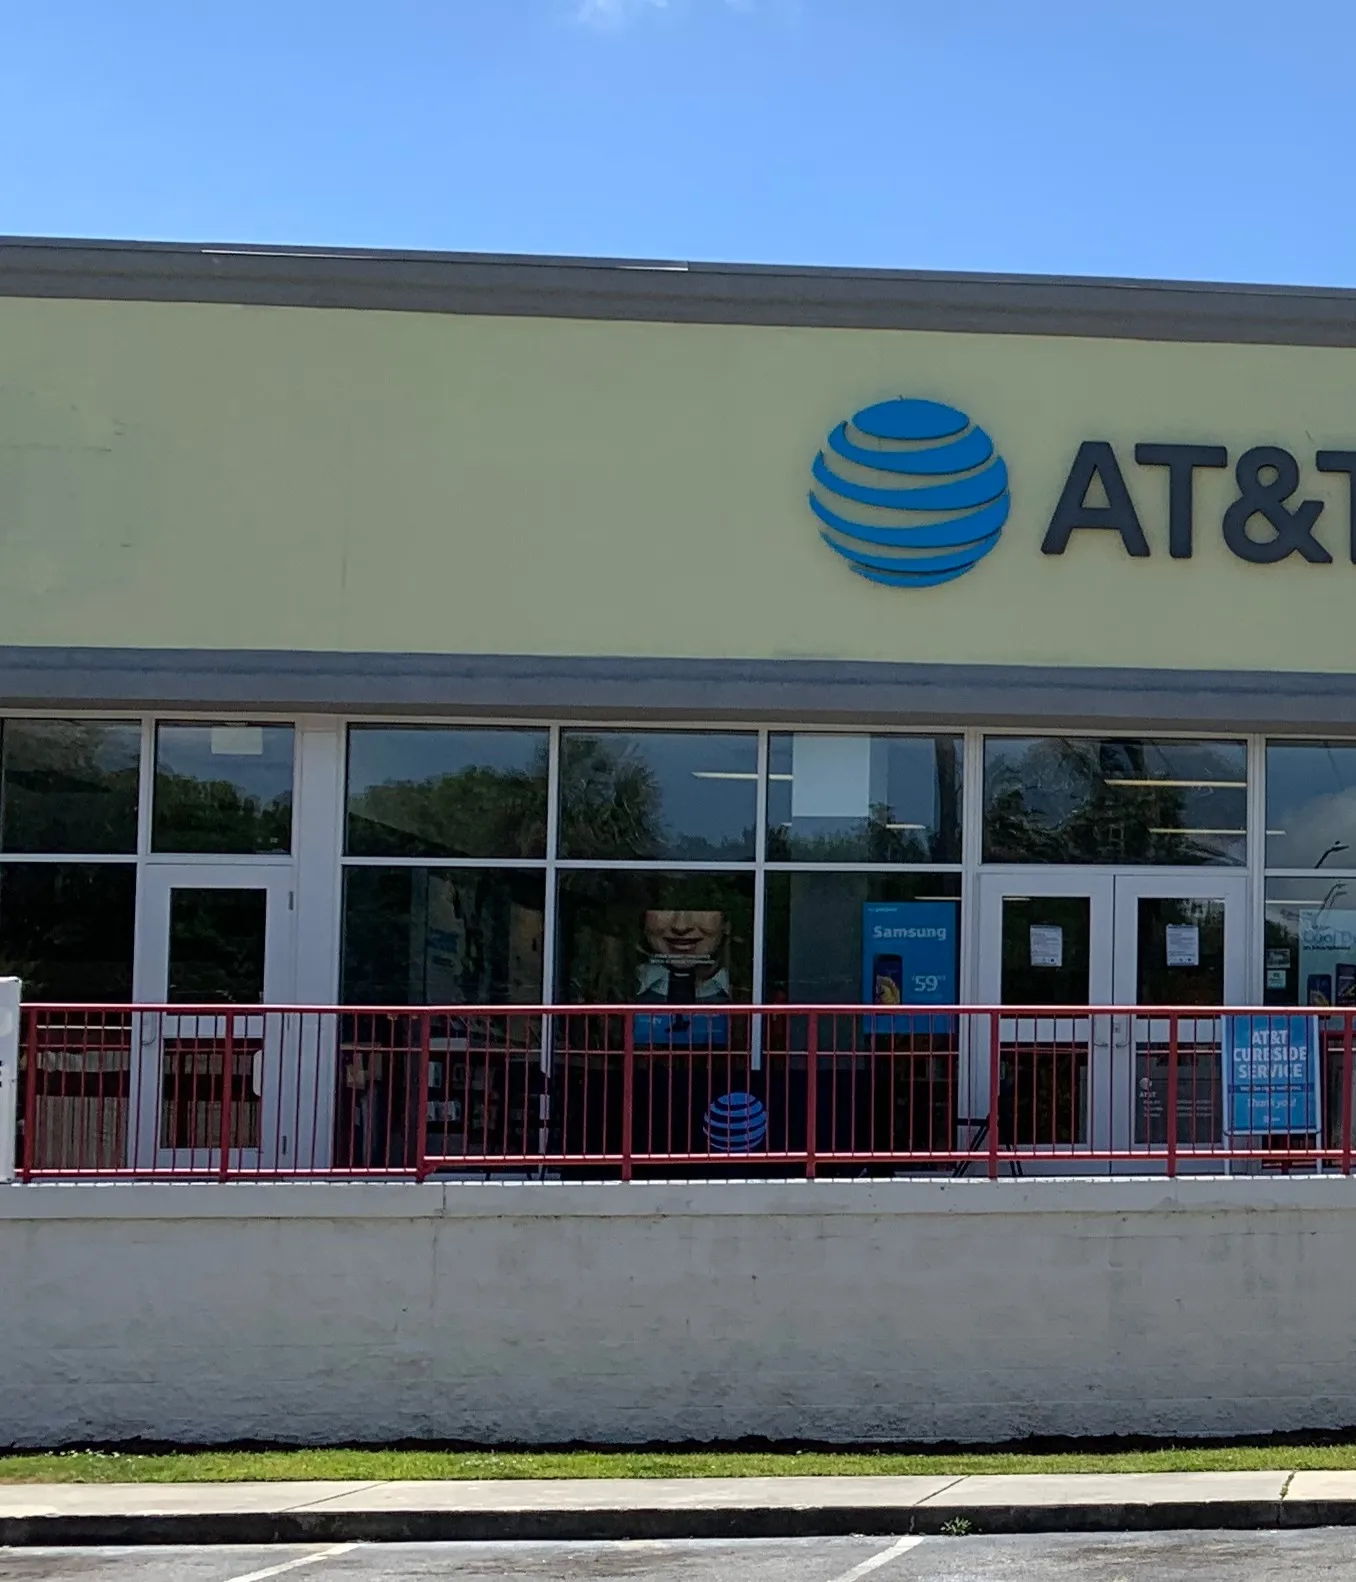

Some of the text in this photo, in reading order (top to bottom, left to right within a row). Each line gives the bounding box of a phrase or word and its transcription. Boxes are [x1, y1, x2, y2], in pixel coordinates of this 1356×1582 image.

[872, 925, 947, 941] Samsung
[1251, 1030, 1289, 1044] AT&T
[1238, 1063, 1303, 1079] SERVICE
